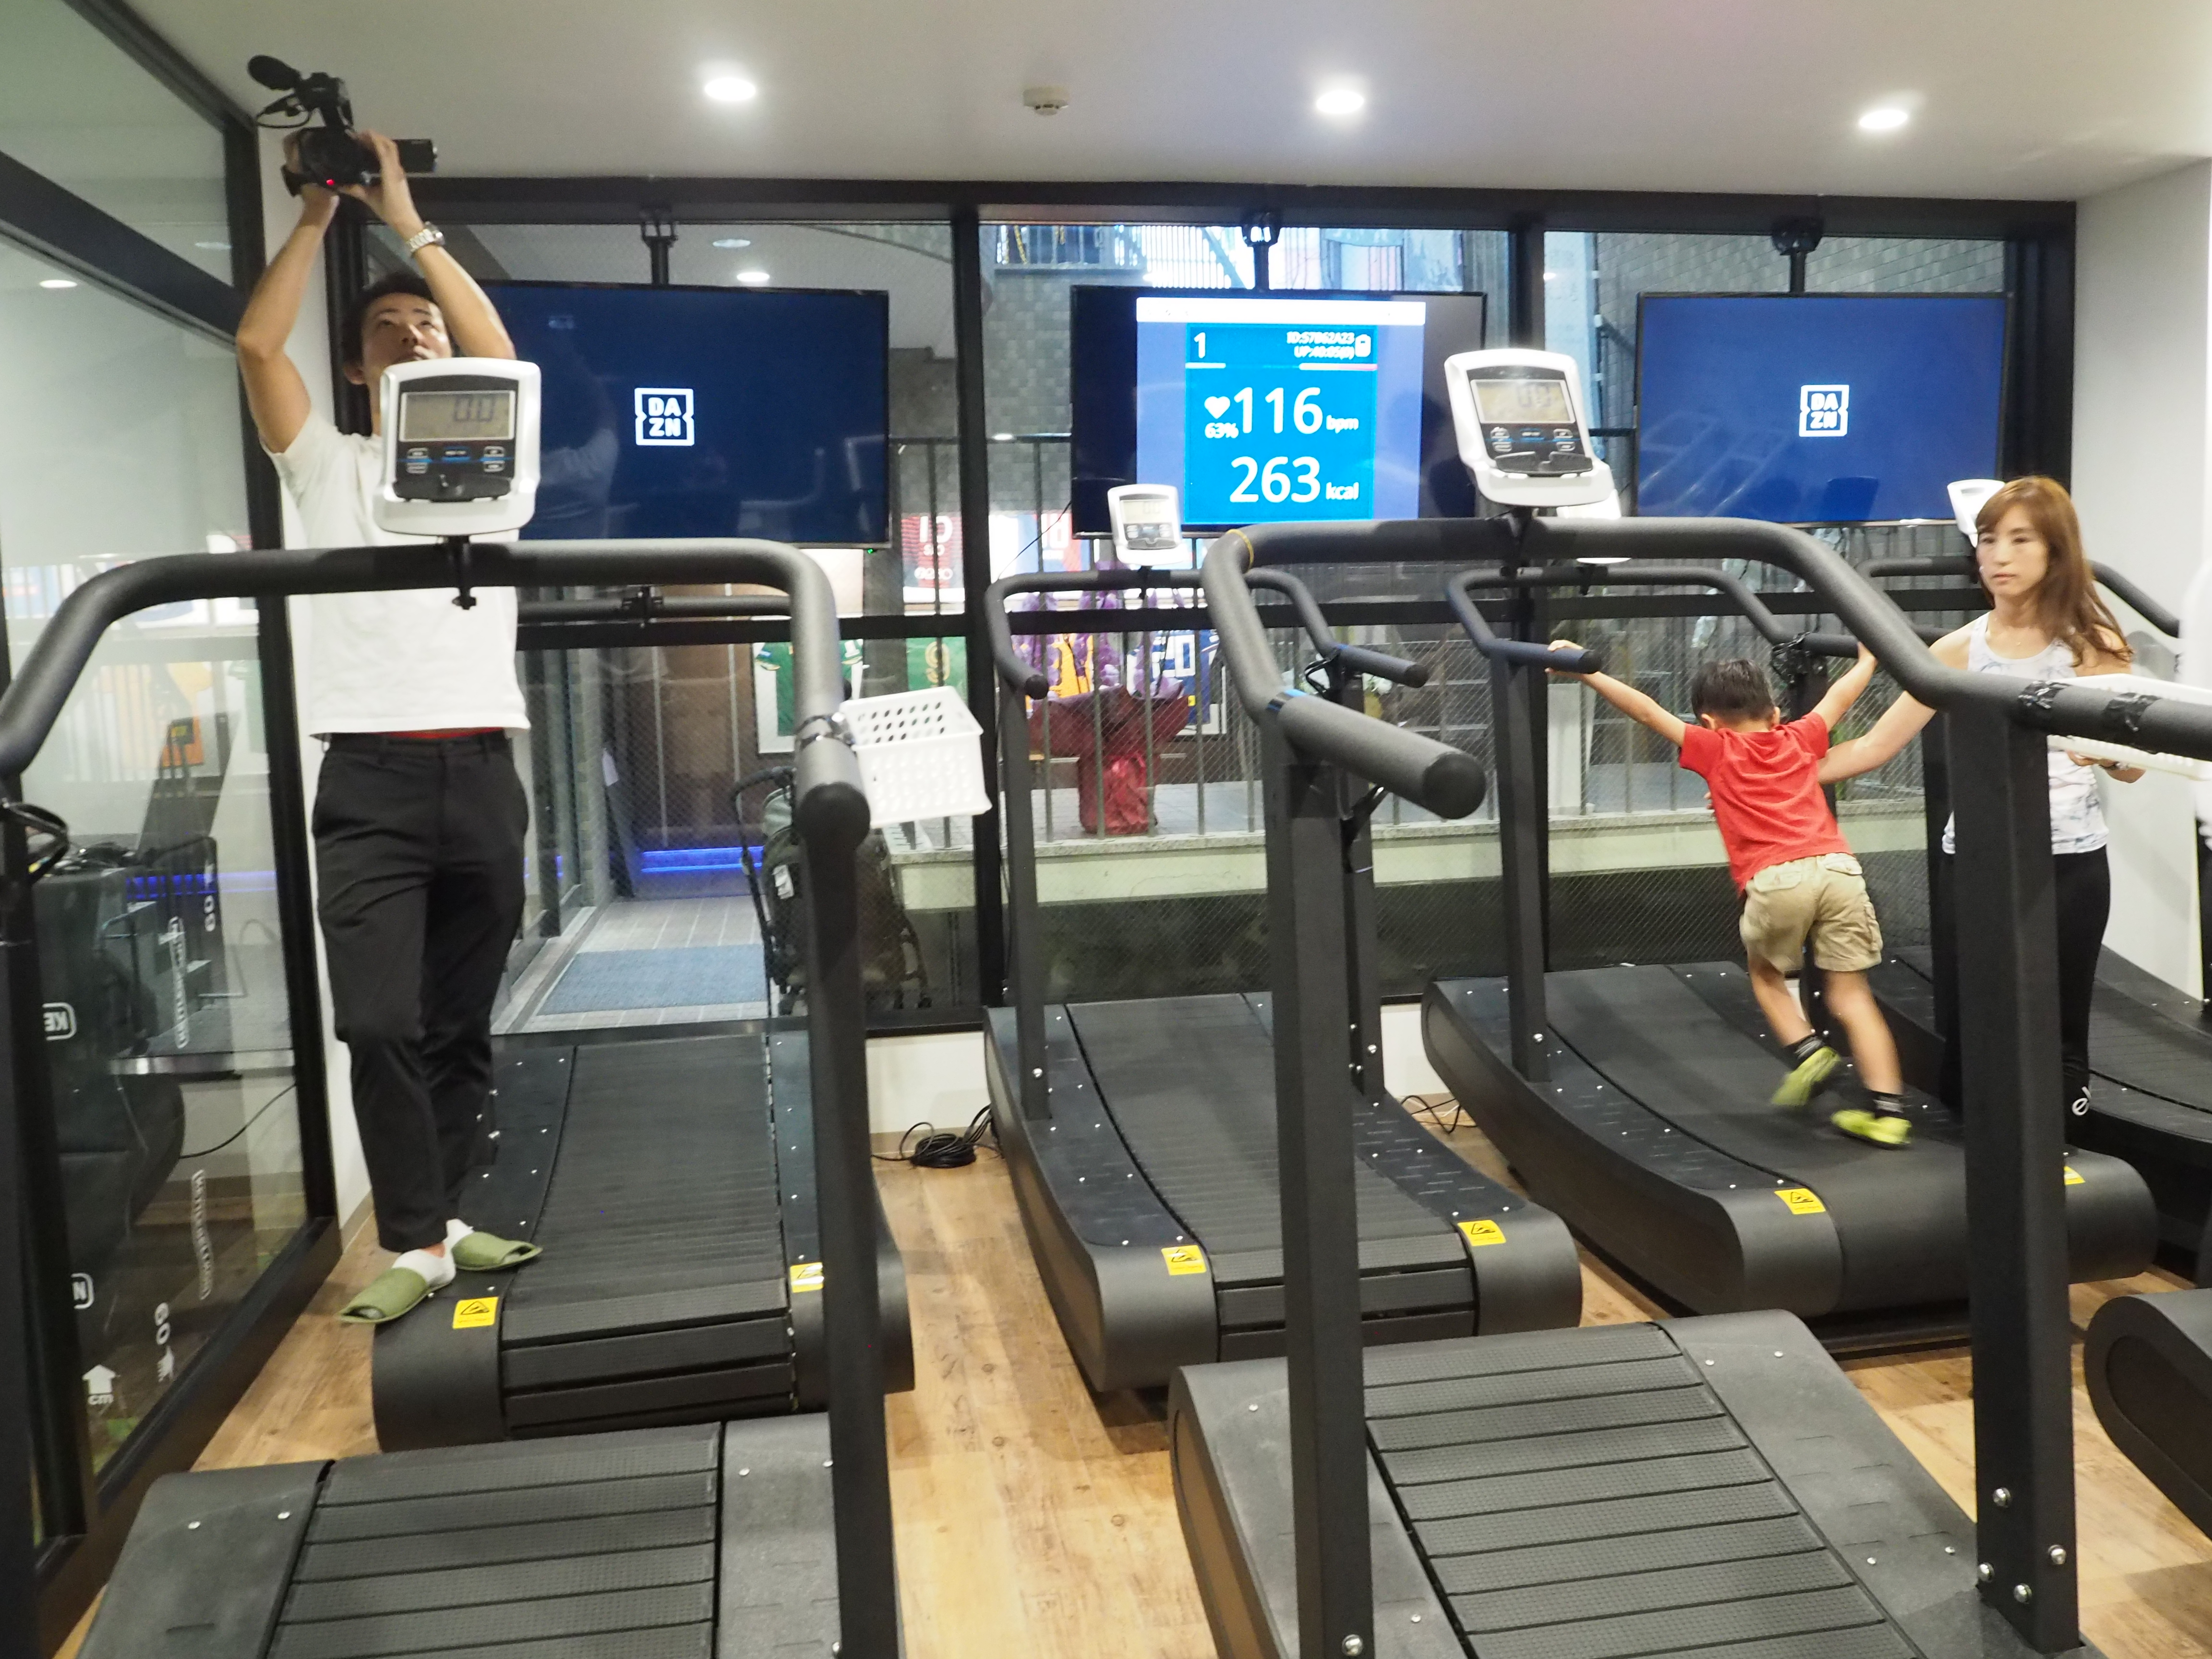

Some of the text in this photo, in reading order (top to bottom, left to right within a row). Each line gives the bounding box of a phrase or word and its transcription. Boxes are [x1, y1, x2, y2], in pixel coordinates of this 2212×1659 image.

[1193, 332, 1206, 358] 1
[1234, 387, 1323, 434] 116
[1326, 415, 1359, 432] bpm
[1229, 456, 1321, 503] 263
[1326, 481, 1359, 500] kcal
